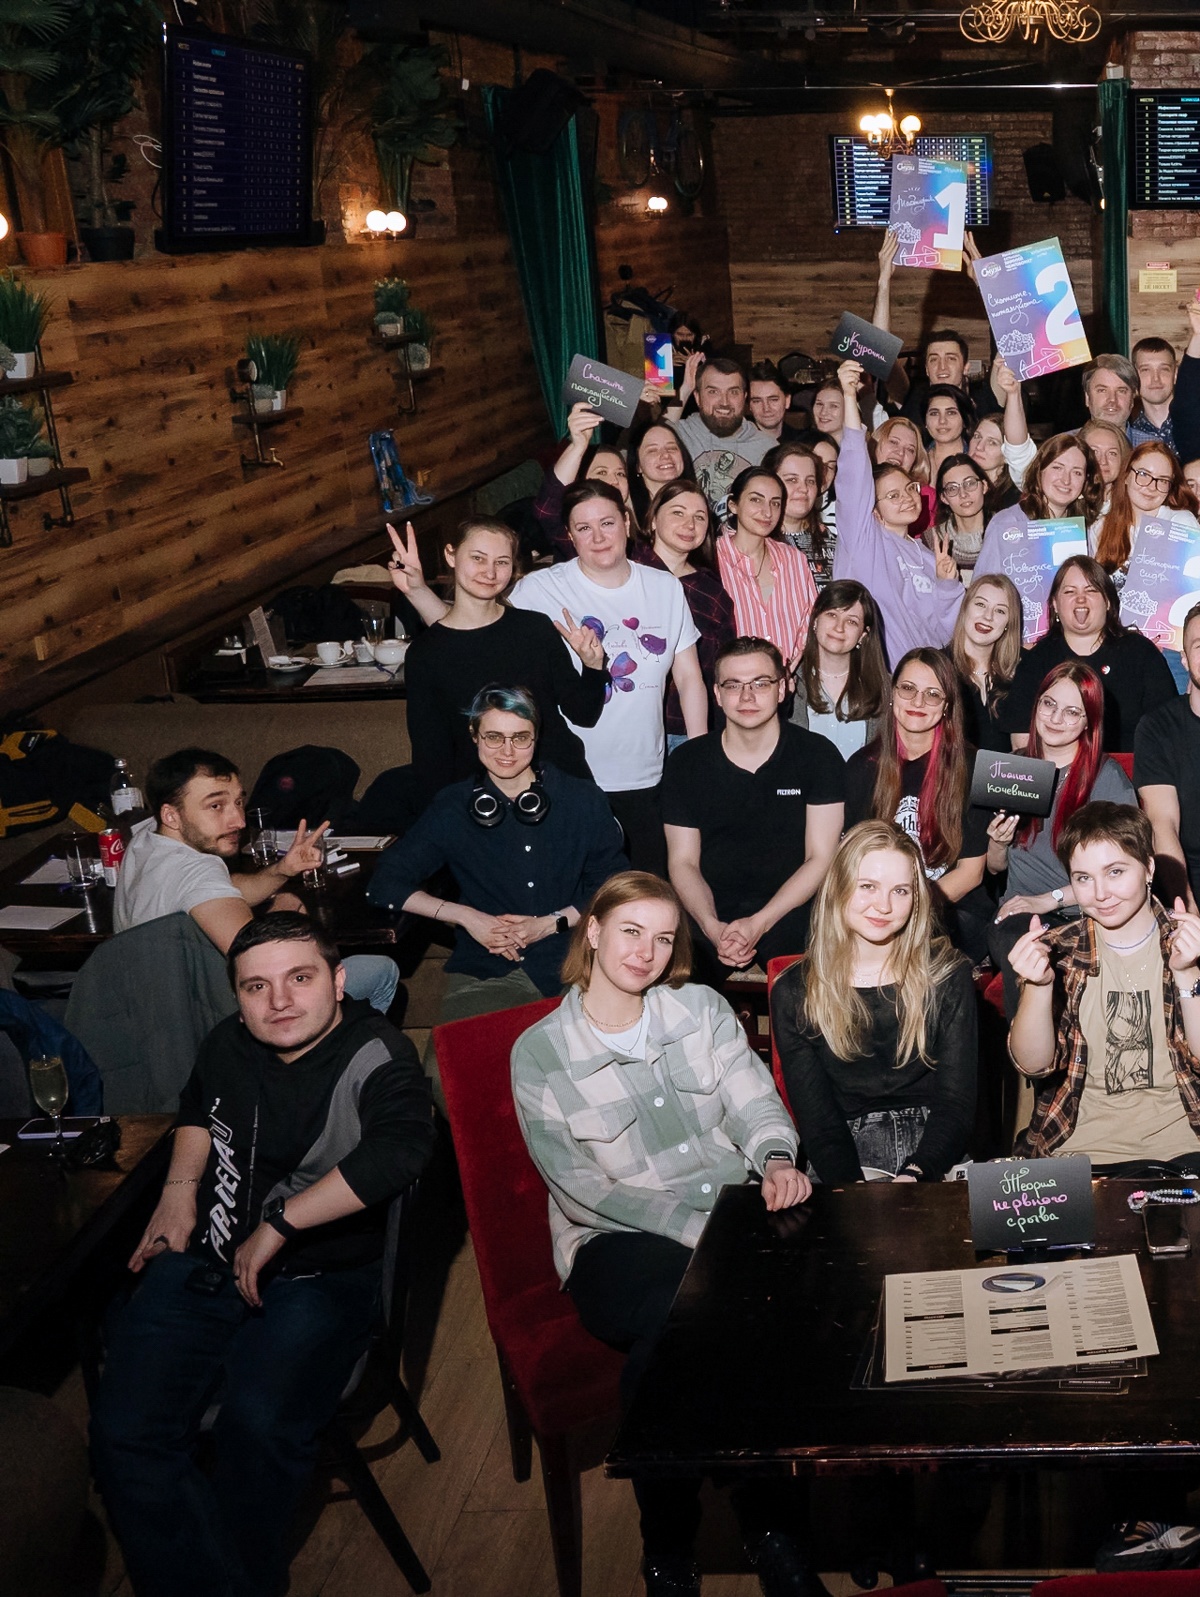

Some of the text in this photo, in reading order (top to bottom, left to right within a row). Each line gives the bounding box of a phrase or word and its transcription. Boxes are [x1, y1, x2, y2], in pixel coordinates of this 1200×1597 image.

[933, 182, 967, 251] 1
[1035, 262, 1087, 346] 2
[656, 343, 673, 377] 1
[1000, 1167, 1057, 1198] Теория
[993, 1193, 1068, 1216] нервного
